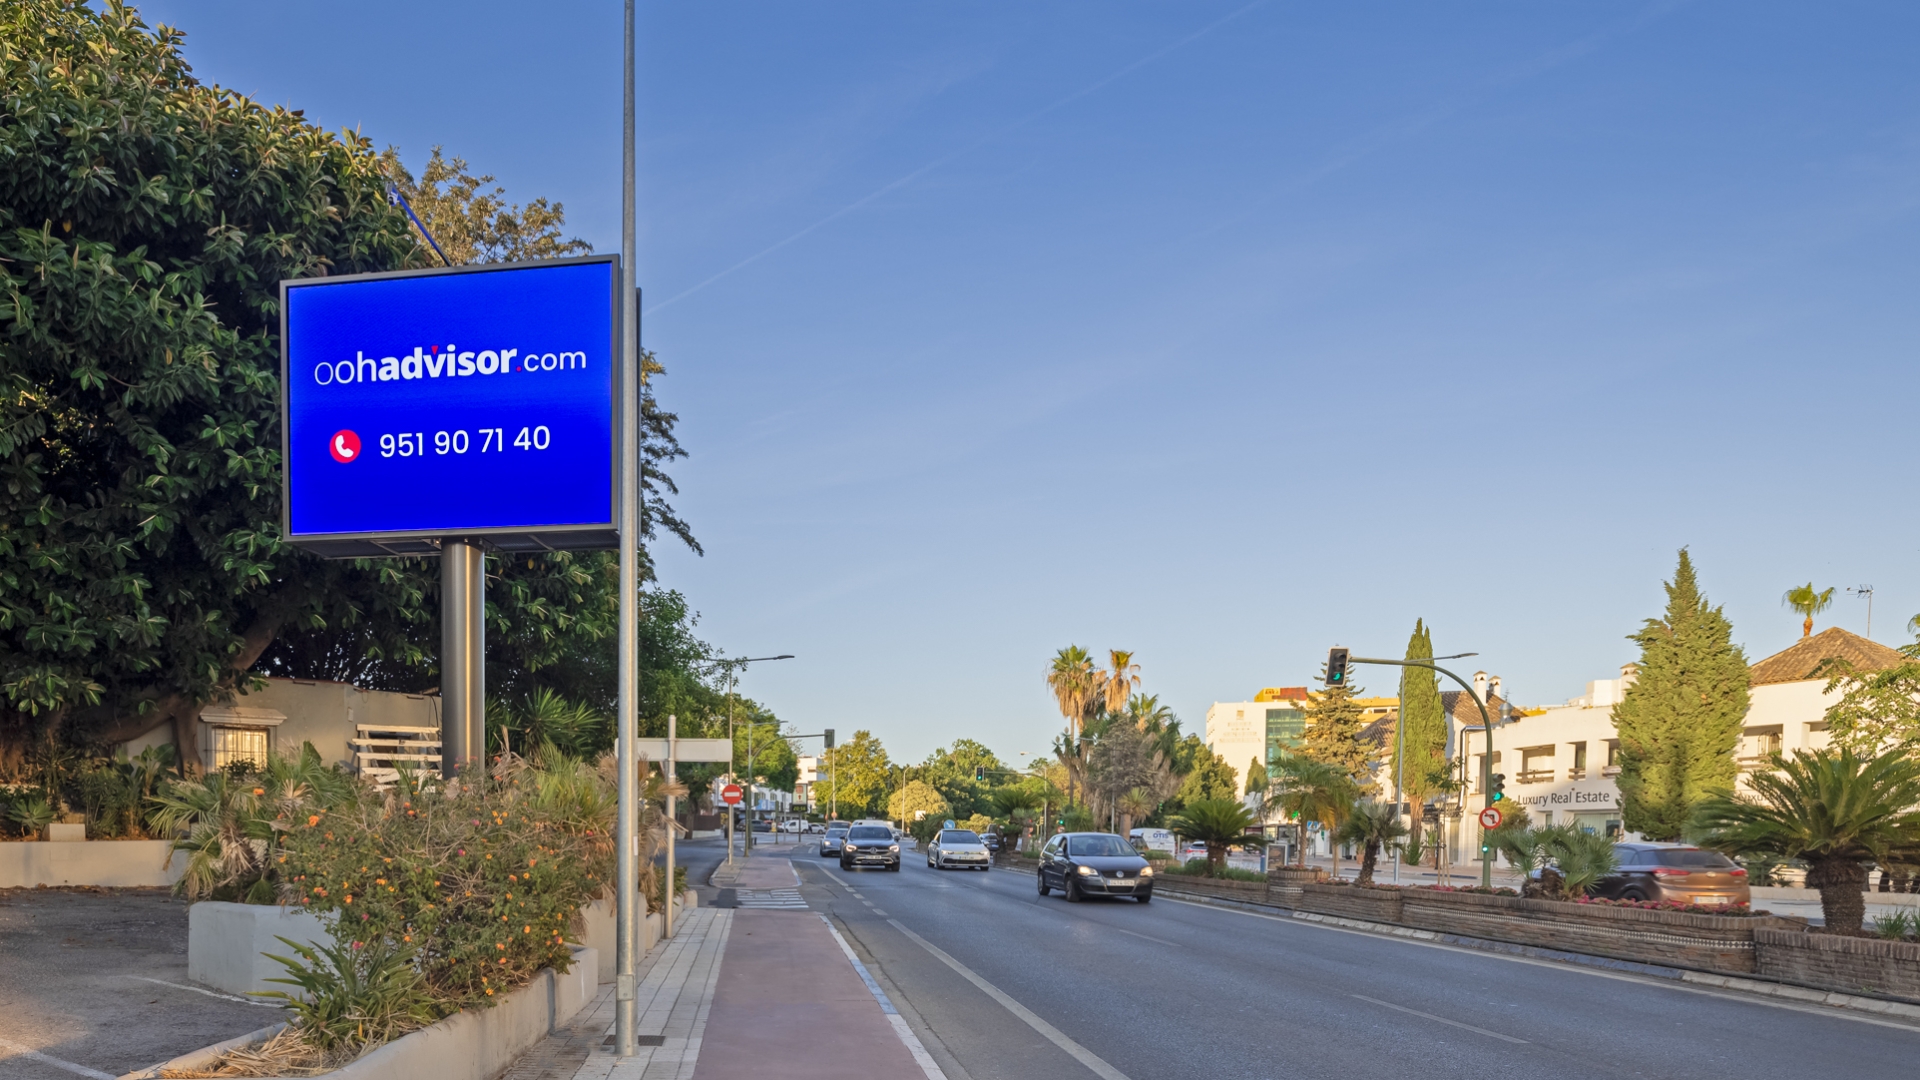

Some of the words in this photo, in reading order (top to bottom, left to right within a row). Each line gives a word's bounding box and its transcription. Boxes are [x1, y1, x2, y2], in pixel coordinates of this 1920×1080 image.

[314, 344, 586, 385] oohadvisor.com
[379, 432, 423, 458] 951
[434, 429, 469, 455] 90
[478, 427, 503, 453] 71
[513, 425, 550, 450] 40
[1518, 795, 1548, 807] Luxury
[1551, 791, 1572, 804] Real
[1576, 791, 1610, 803] Estate
